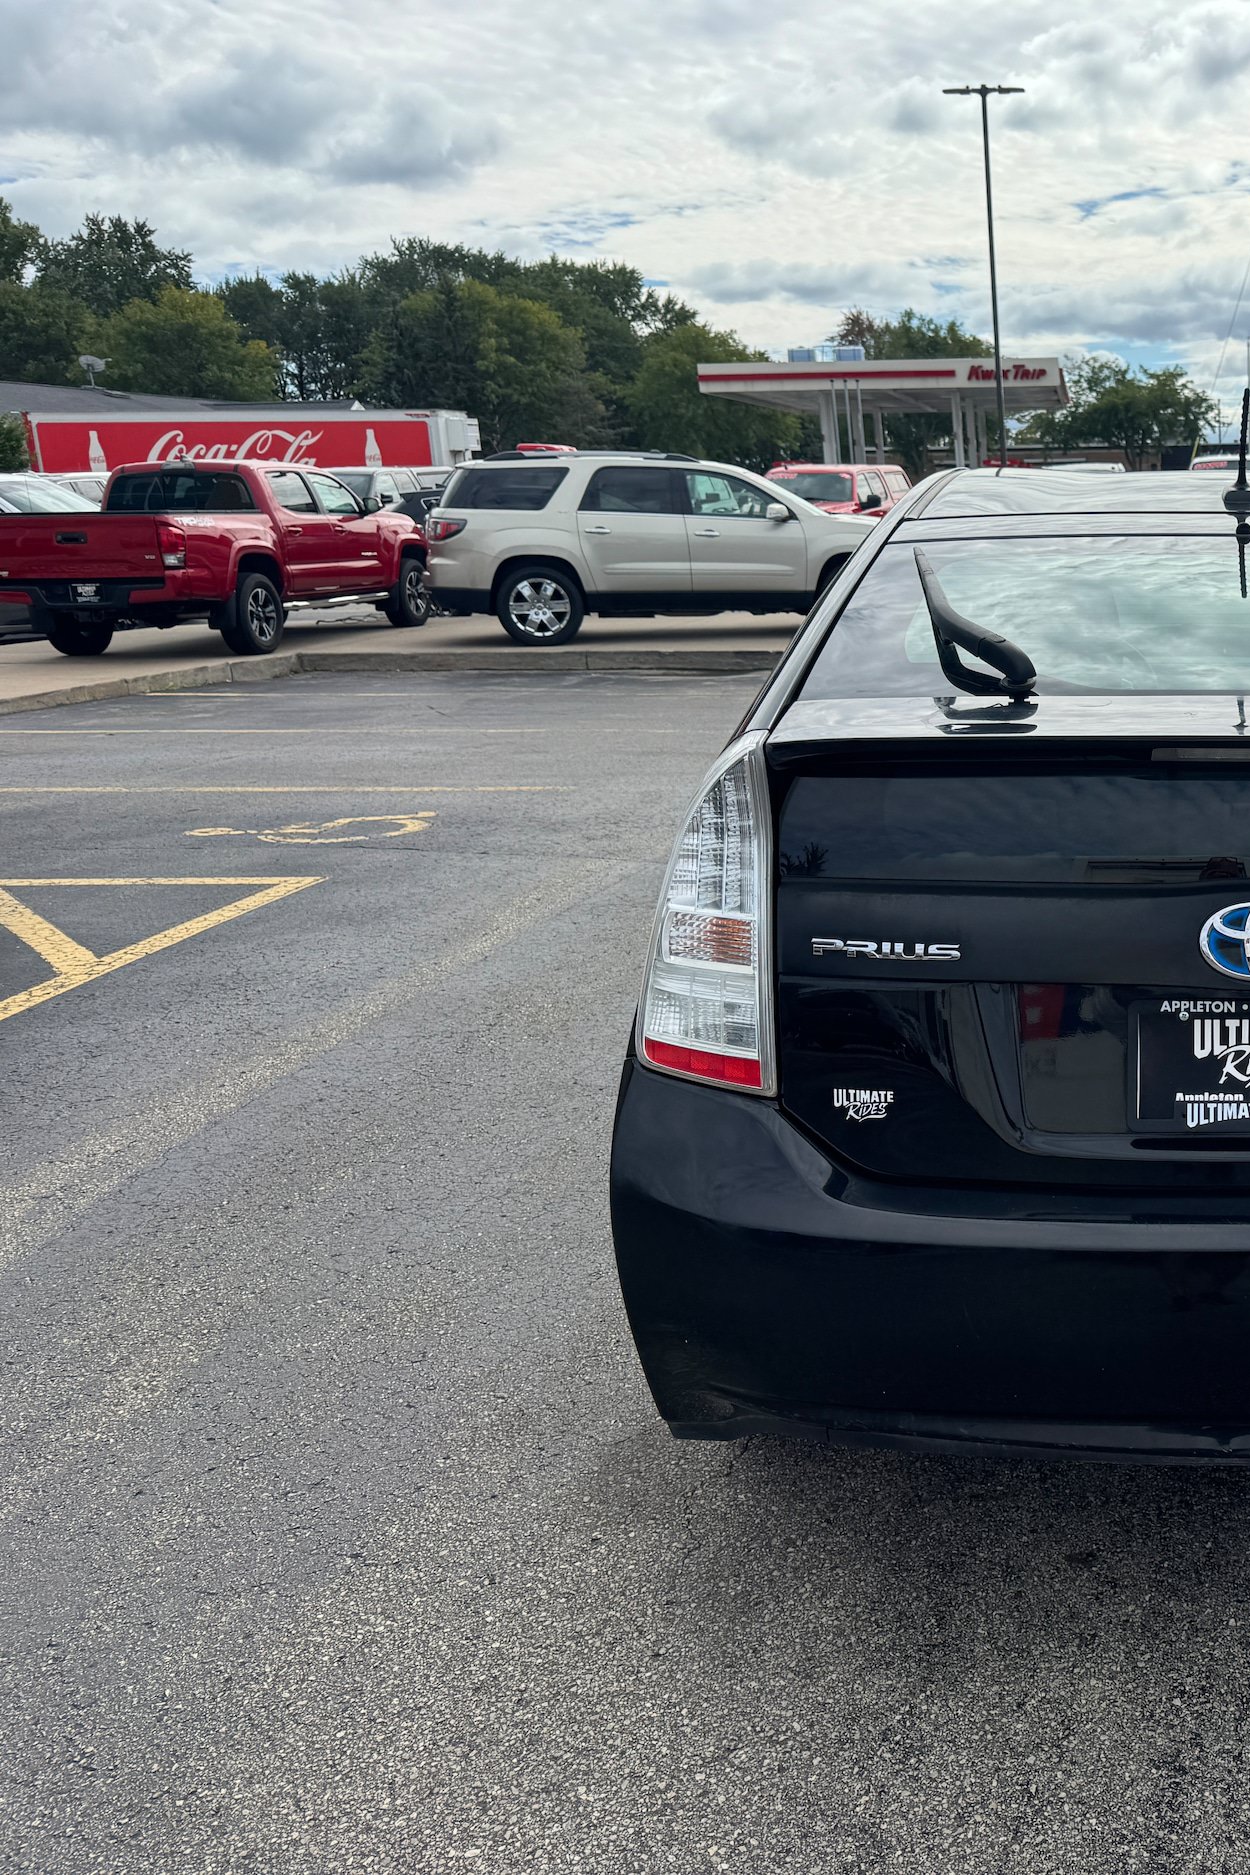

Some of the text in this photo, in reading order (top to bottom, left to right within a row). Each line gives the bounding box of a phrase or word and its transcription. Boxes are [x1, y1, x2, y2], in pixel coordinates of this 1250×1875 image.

[1012, 364, 1047, 381] TRIP
[810, 936, 962, 962] PRIUS
[1160, 1000, 1236, 1013] APPLETON
[833, 1088, 895, 1108] ULTIMATE
